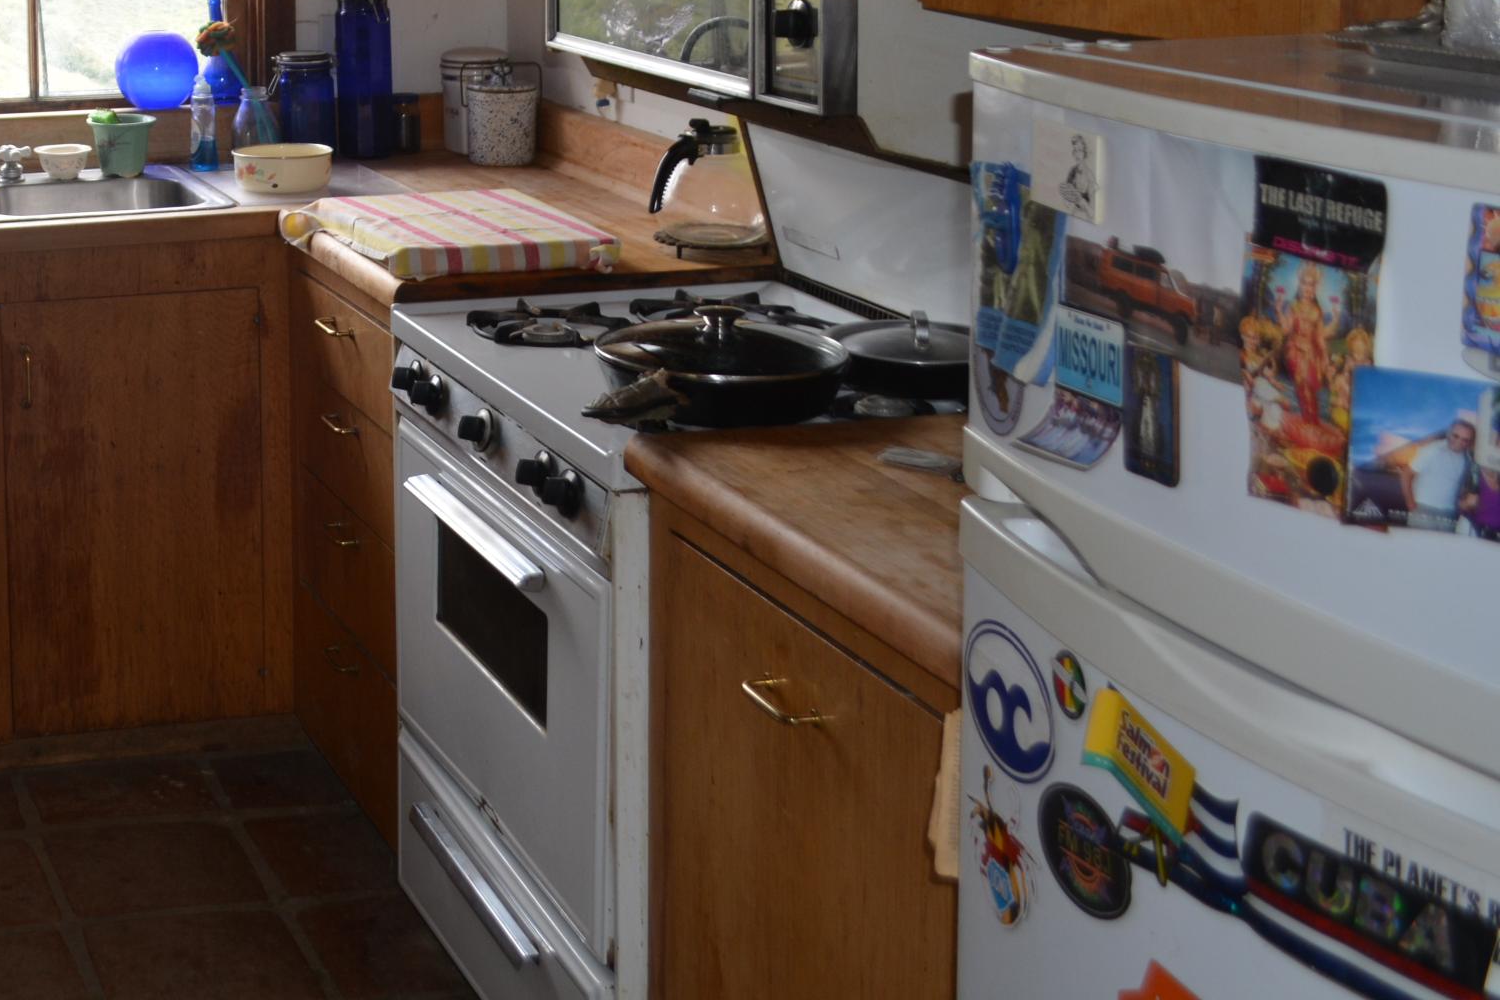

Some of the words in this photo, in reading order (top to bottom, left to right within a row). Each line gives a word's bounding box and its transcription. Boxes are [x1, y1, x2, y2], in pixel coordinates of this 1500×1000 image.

[1259, 183, 1286, 208] THE
[1287, 189, 1324, 217] LAST
[1325, 199, 1383, 233] REFUGE
[1057, 325, 1121, 388] MISSOURI
[1343, 827, 1376, 865] THE
[1262, 831, 1454, 973] CUBA
